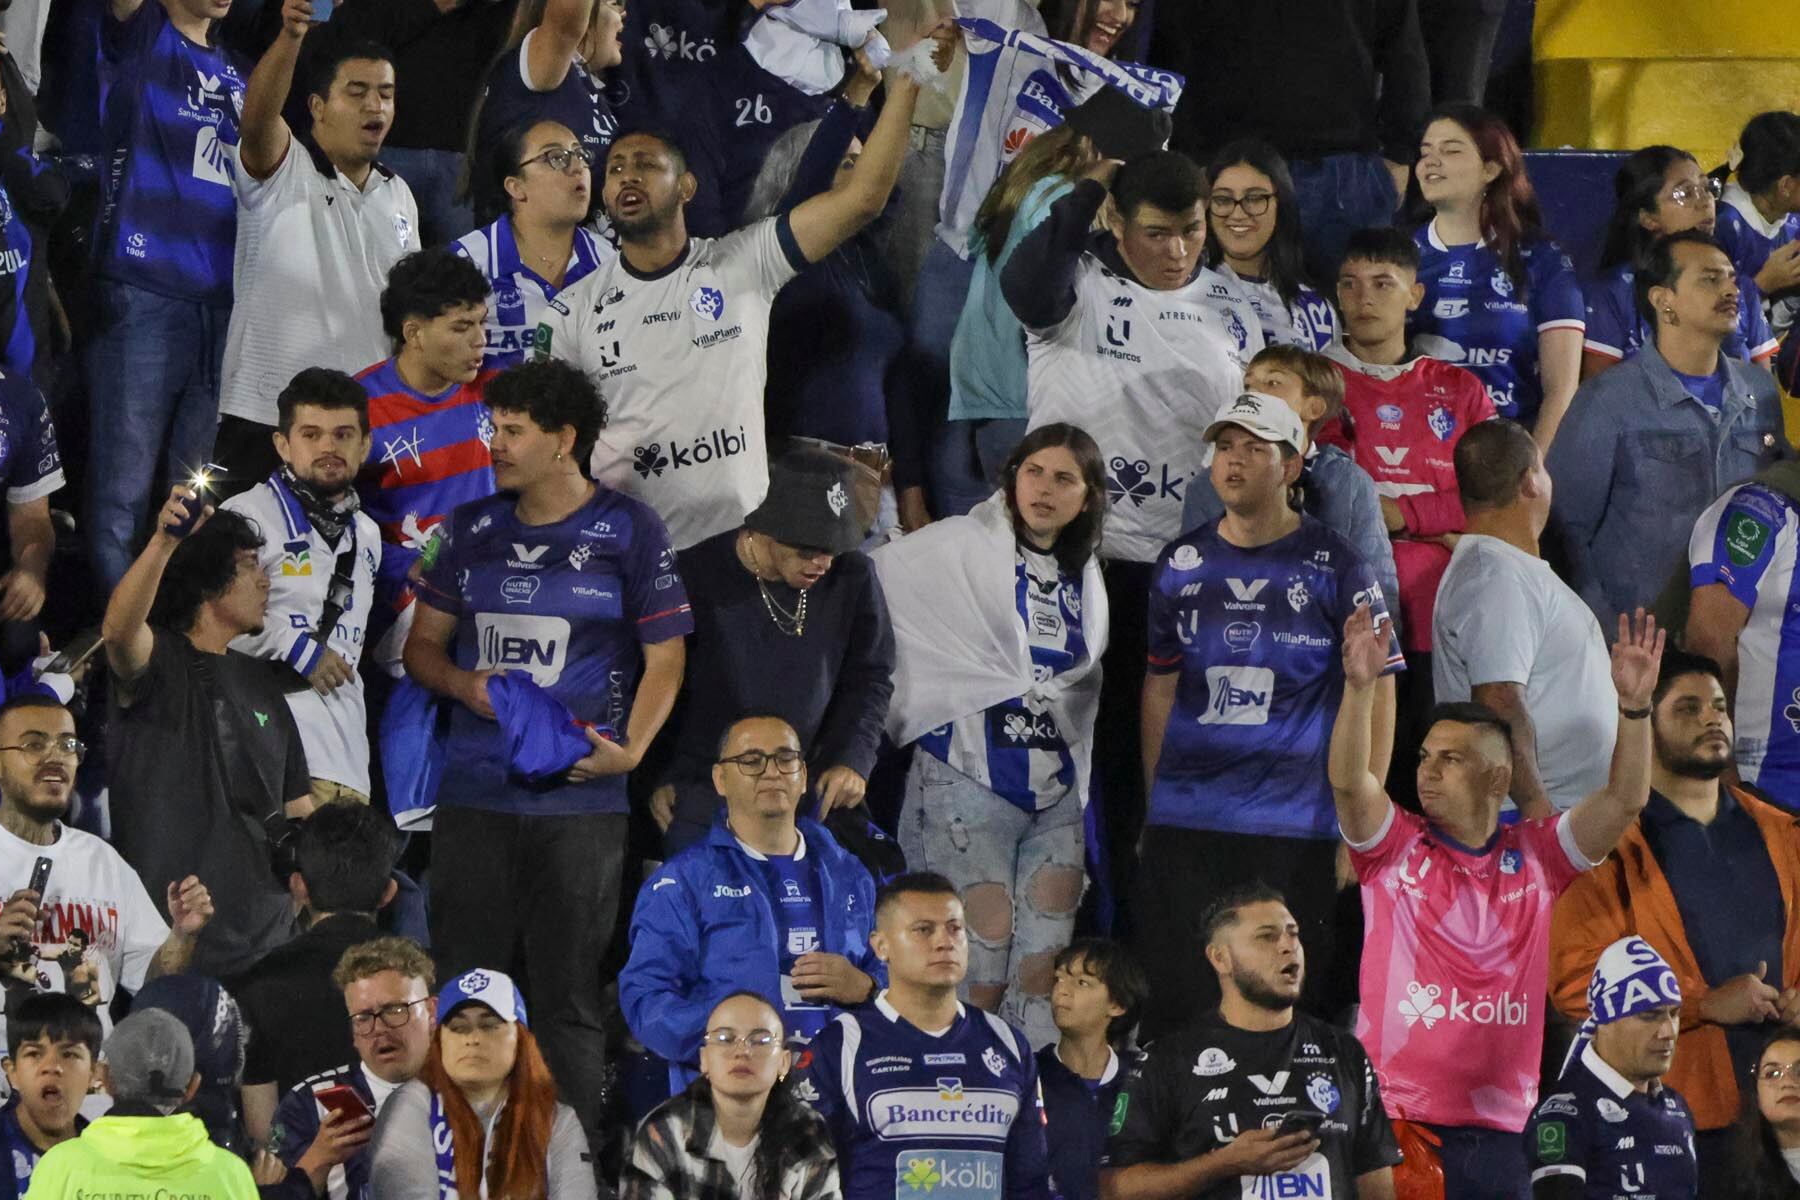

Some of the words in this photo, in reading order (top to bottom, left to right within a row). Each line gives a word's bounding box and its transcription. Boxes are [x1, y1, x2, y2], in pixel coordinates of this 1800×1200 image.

[1159, 311, 1202, 322] ATREVIA
[693, 325, 742, 347] VillaPlants
[1112, 348, 1142, 364] Marcos
[1469, 347, 1513, 364] INS
[612, 362, 638, 377] Marcos
[669, 424, 747, 471] kölbi
[503, 581, 533, 590] NUTRI
[572, 587, 613, 599] VillaPlants
[1273, 633, 1331, 647] VillaPlants
[502, 637, 556, 666] BN
[1228, 688, 1266, 707] BN
[1449, 985, 1529, 1028] kölbi
[872, 1065, 910, 1076] CARTAGO
[887, 1102, 1013, 1127] Bancrédito
[941, 1157, 999, 1190] kölbi
[1279, 1173, 1325, 1198] BN
